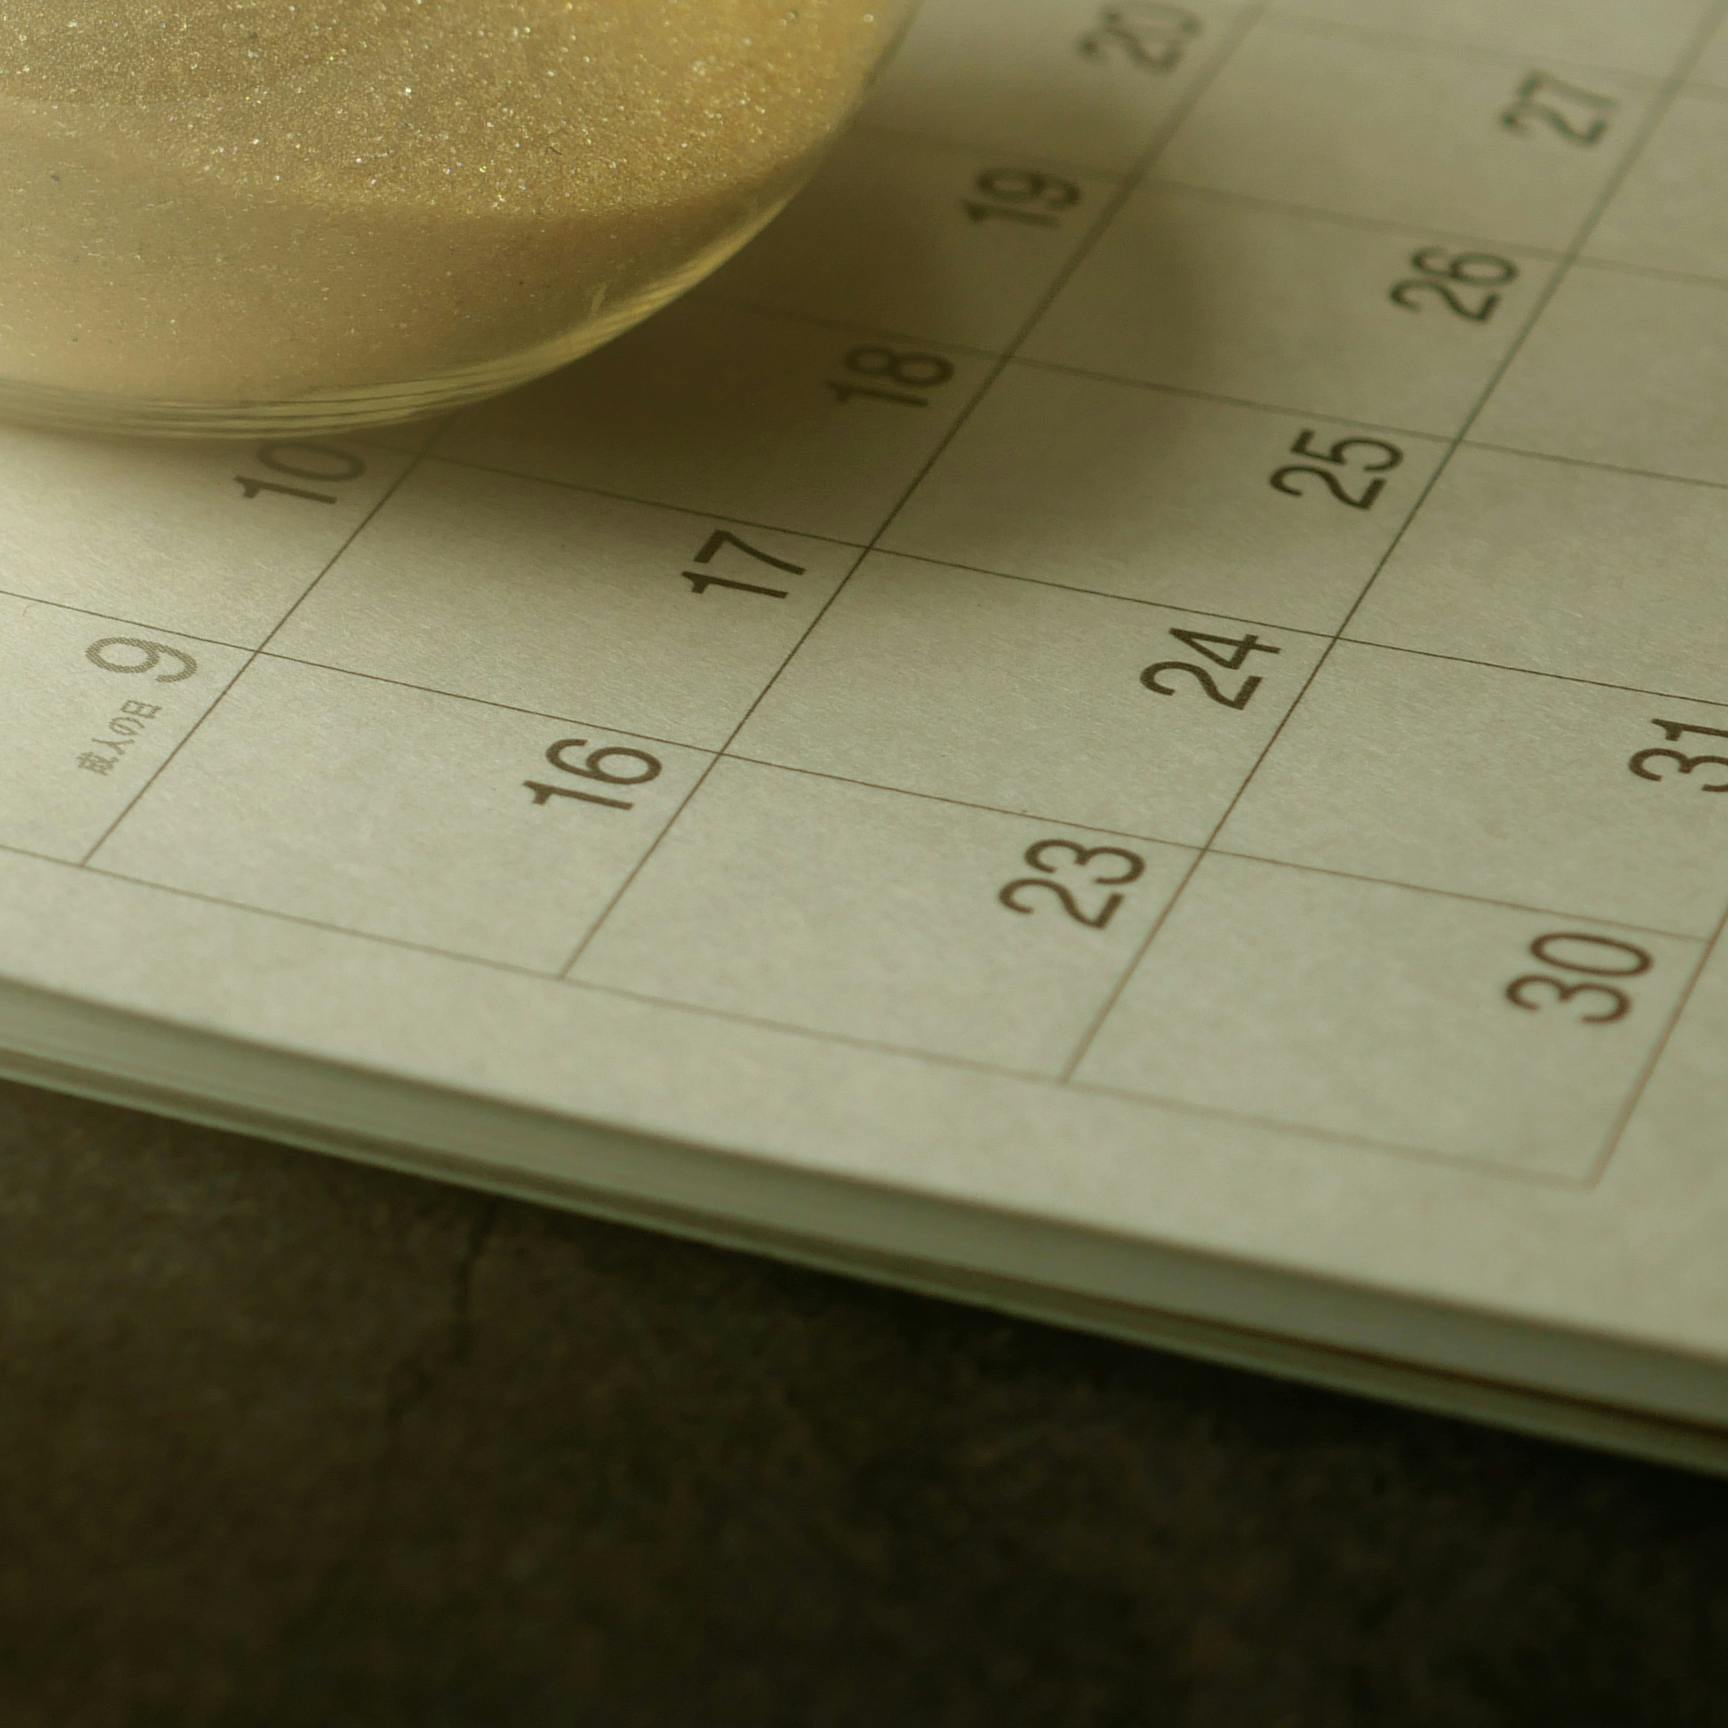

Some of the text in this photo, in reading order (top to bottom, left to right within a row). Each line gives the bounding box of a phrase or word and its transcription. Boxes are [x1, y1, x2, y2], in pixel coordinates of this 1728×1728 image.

[1497, 69, 1620, 150] 27
[960, 165, 1082, 229] 19
[1389, 244, 1518, 324] 26
[824, 342, 956, 410] 18
[233, 439, 368, 505] 10
[1269, 428, 1405, 510] 25
[681, 530, 807, 600] 17
[85, 636, 198, 683] 9
[1139, 627, 1282, 710] 24
[76, 699, 162, 777] 成人の日
[522, 737, 663, 812] 16
[1628, 718, 1728, 793] 31
[998, 837, 1147, 930] 23
[1504, 930, 1655, 1025] 30
